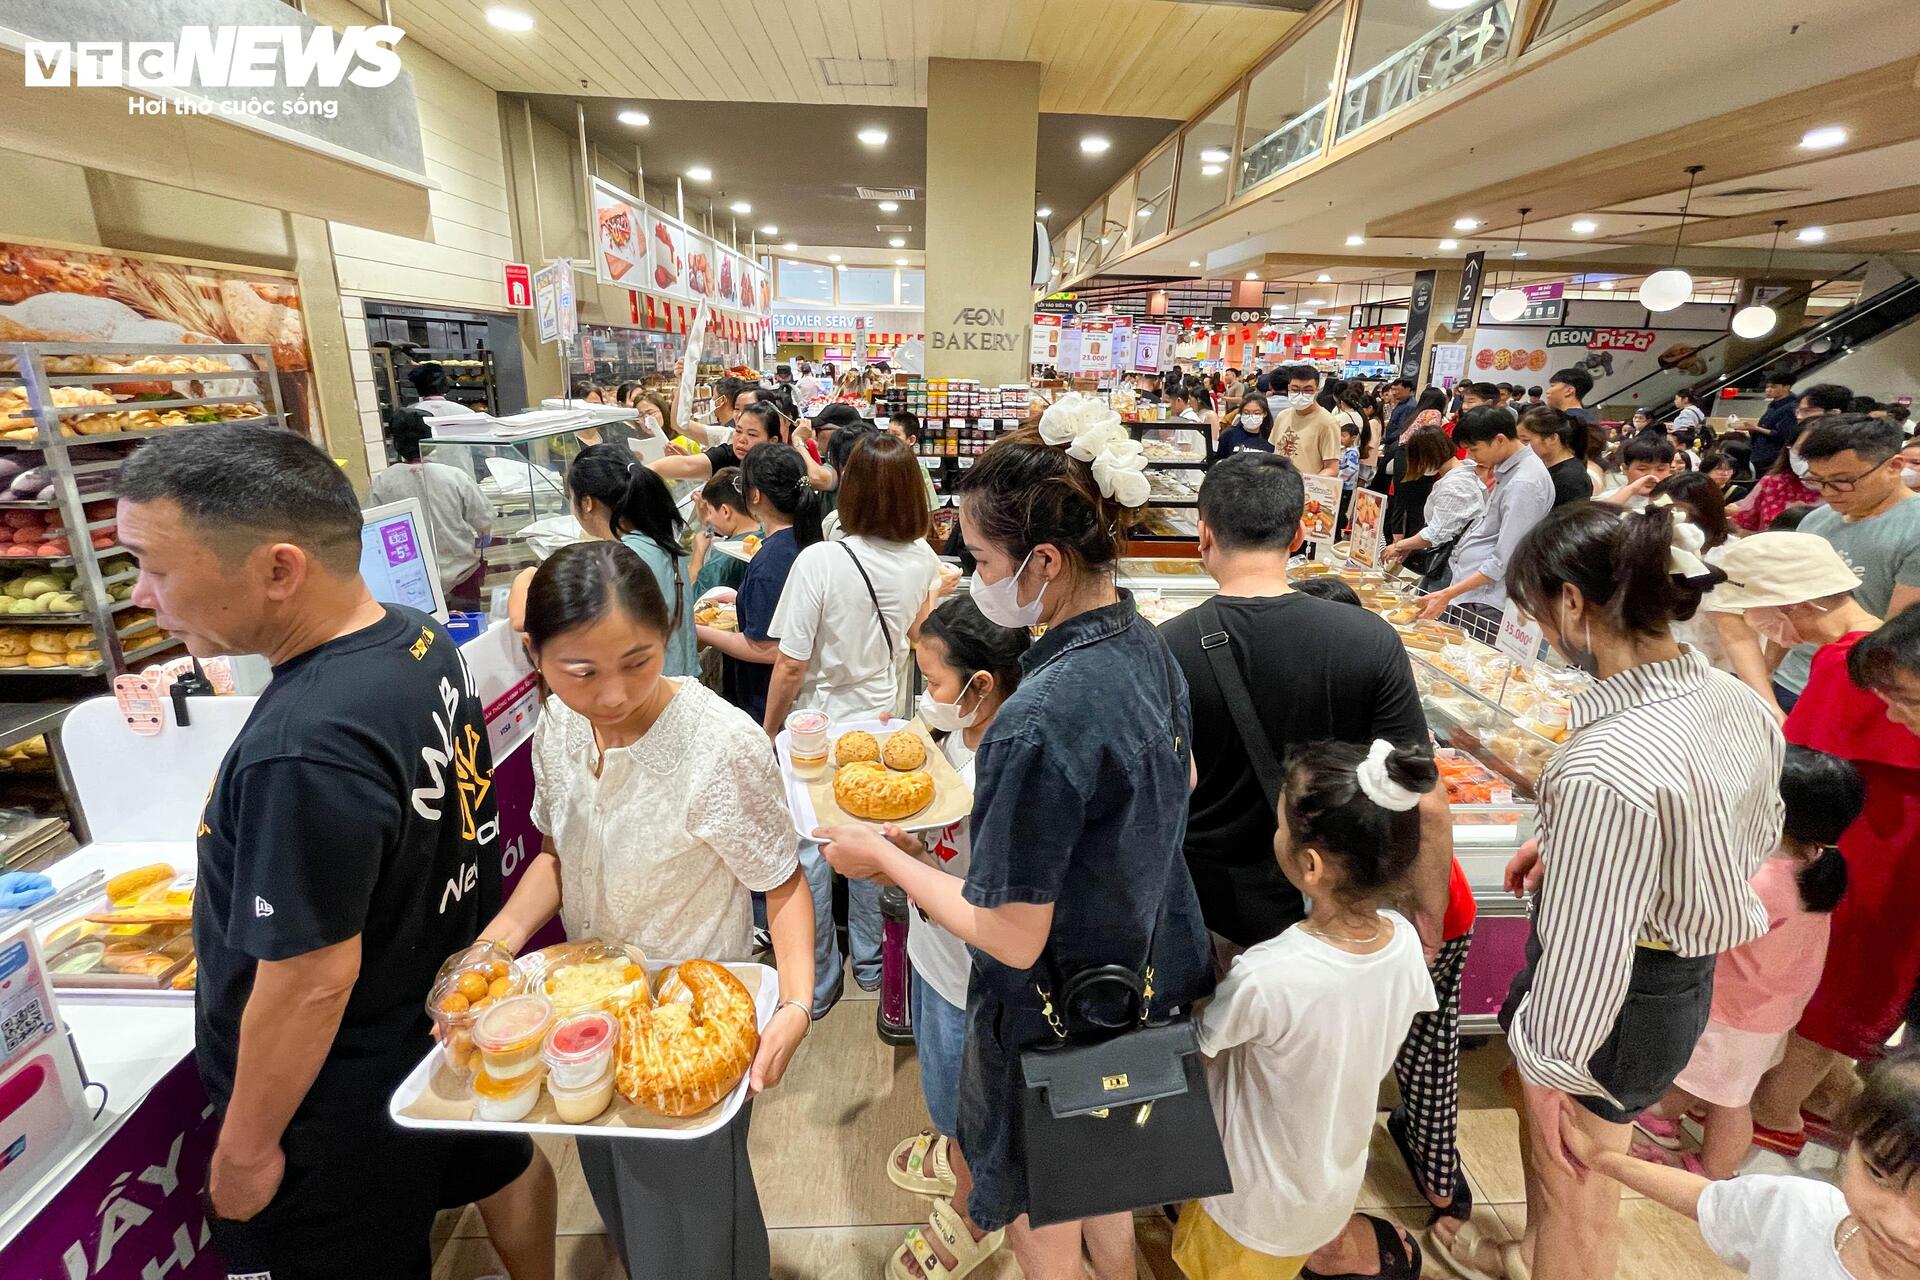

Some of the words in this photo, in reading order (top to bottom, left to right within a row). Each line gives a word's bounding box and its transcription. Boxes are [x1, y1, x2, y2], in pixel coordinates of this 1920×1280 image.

[1462, 284, 1472, 301] 2
[932, 331, 1020, 351] BAKERY
[1548, 330, 1592, 345] AEON
[500, 722, 512, 736] VISA
